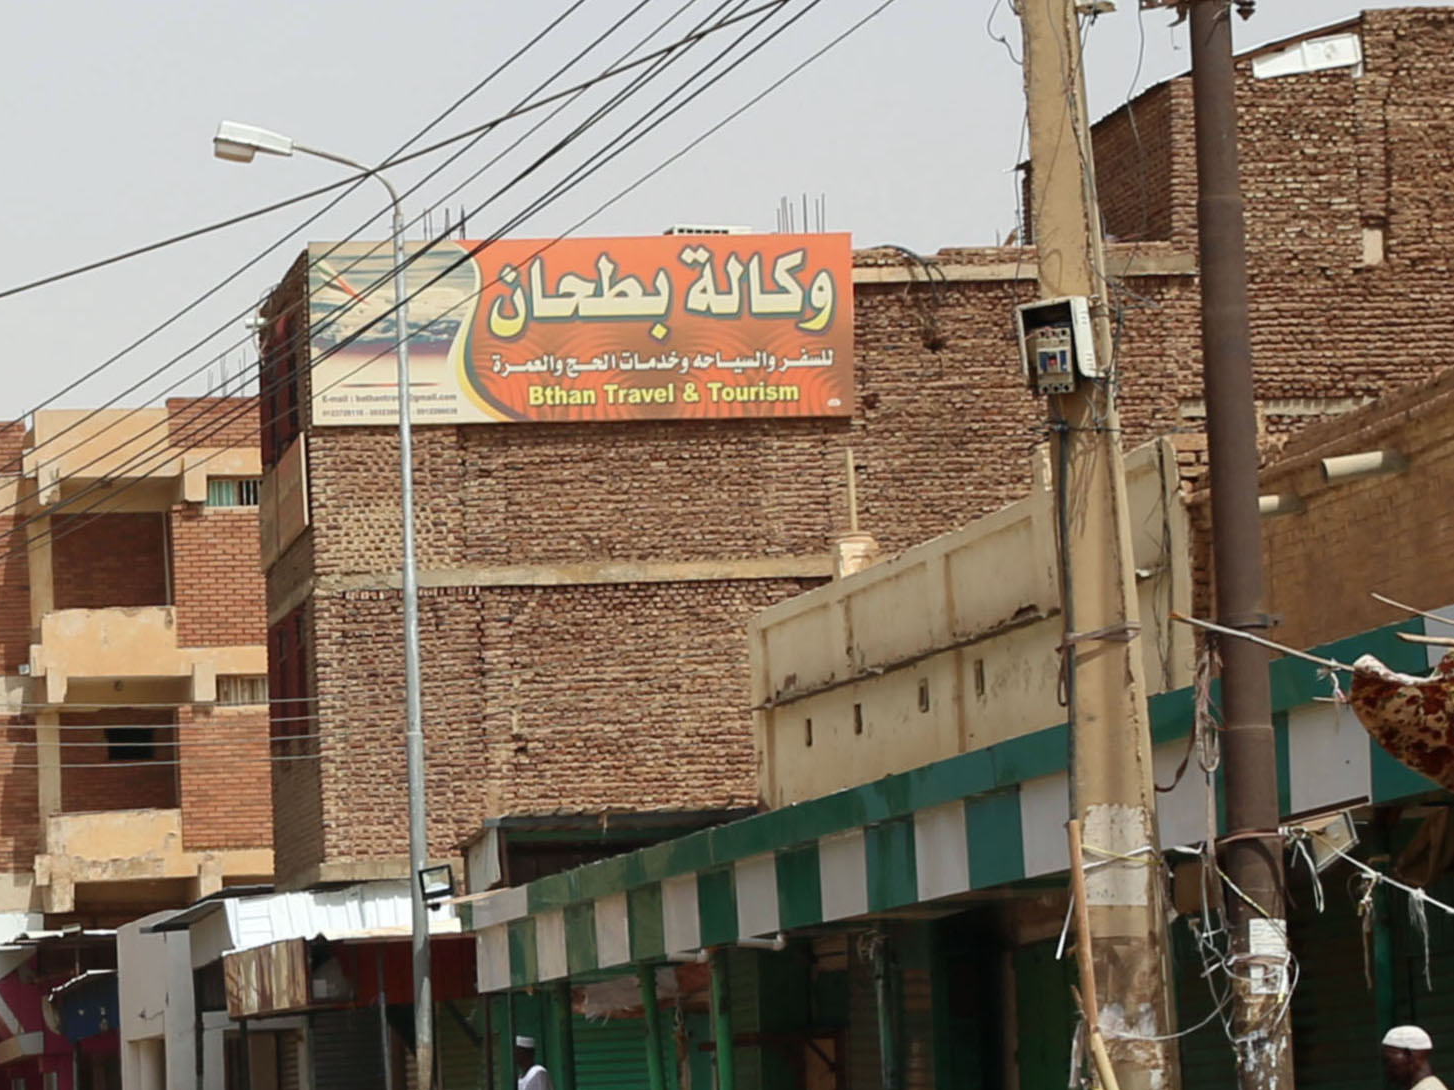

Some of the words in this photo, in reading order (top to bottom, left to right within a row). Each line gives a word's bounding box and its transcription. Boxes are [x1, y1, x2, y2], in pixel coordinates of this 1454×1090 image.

[489, 253, 671, 340] بطحان
[680, 245, 835, 331] وكالة
[492, 354, 563, 377] والعمرة
[565, 353, 617, 377] الحج
[619, 352, 689, 374] وخدمات
[781, 350, 834, 371] للسفر
[529, 386, 596, 405] Bthan
[603, 383, 674, 404] Travel
[683, 384, 700, 402] &
[707, 382, 799, 401] Tourism
